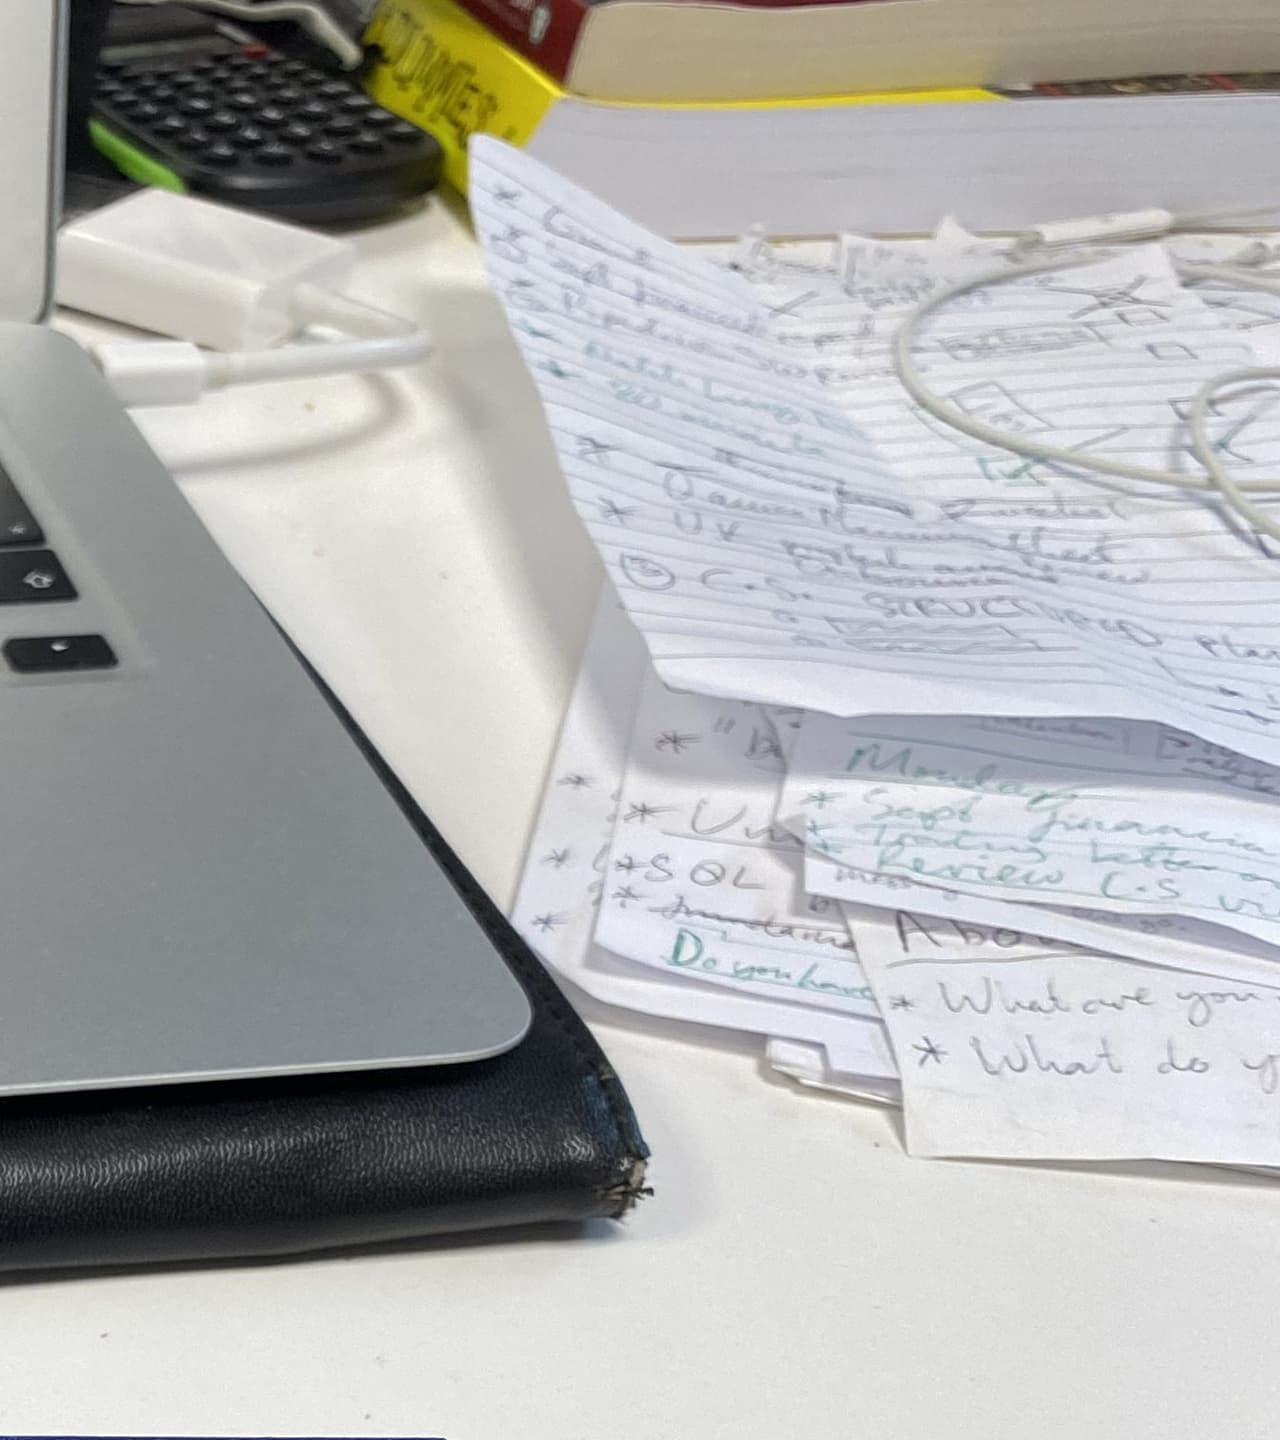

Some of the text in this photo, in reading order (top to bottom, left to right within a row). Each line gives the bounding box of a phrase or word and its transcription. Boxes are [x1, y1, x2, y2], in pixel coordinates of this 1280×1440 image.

[645, 853, 767, 890] SQL
[668, 927, 718, 967] Do
[896, 909, 1062, 953] Abo
[939, 976, 1070, 1015] What
[969, 1034, 1125, 1076] What
[1156, 1039, 1210, 1075] do
